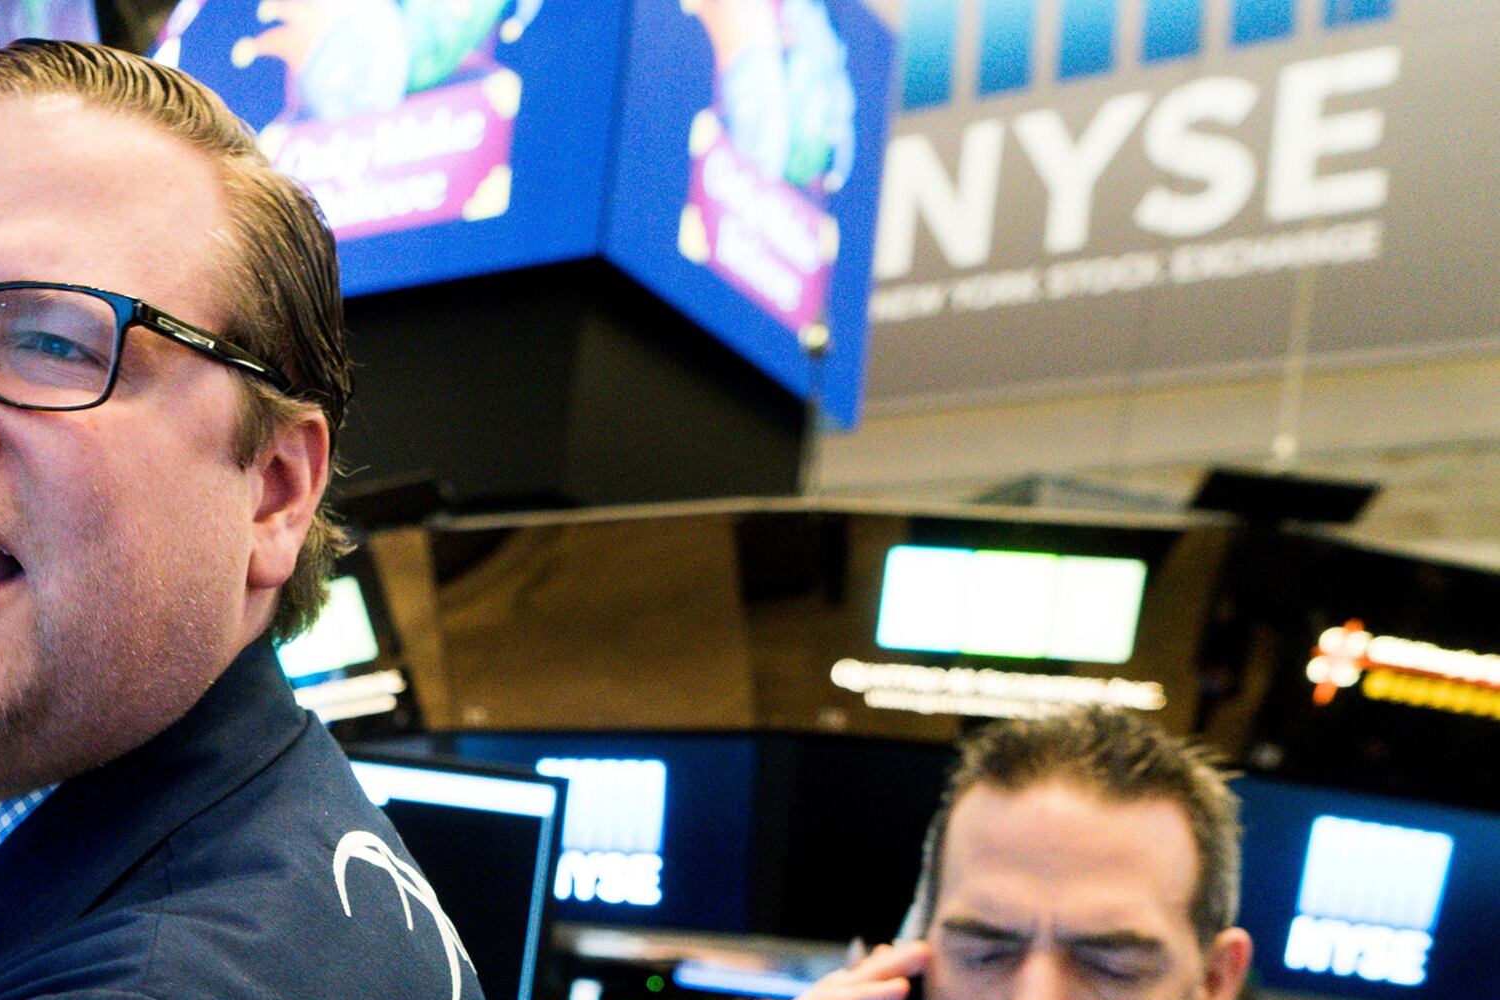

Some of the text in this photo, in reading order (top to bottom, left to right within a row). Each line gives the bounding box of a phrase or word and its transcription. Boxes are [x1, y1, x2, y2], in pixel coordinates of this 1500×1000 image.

[872, 44, 1400, 280] NYSE
[1043, 251, 1161, 299] STOCK
[1168, 218, 1384, 282] EXCHANGE
[1284, 914, 1433, 986] NYSE
